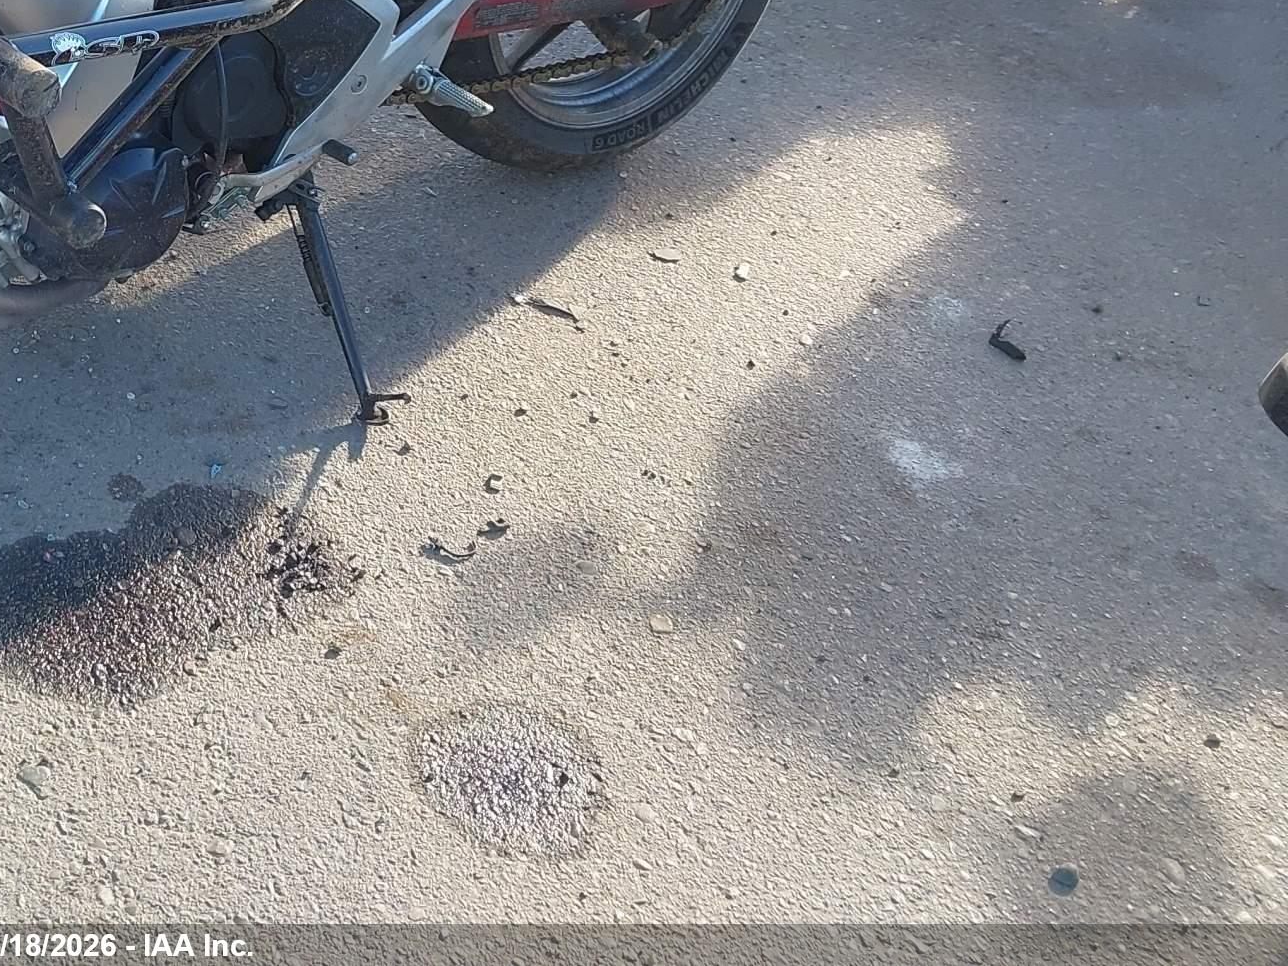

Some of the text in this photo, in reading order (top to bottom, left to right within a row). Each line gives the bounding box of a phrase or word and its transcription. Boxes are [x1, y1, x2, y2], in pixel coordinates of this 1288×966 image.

[592, 48, 728, 150] MICHELIN ROAD 6
